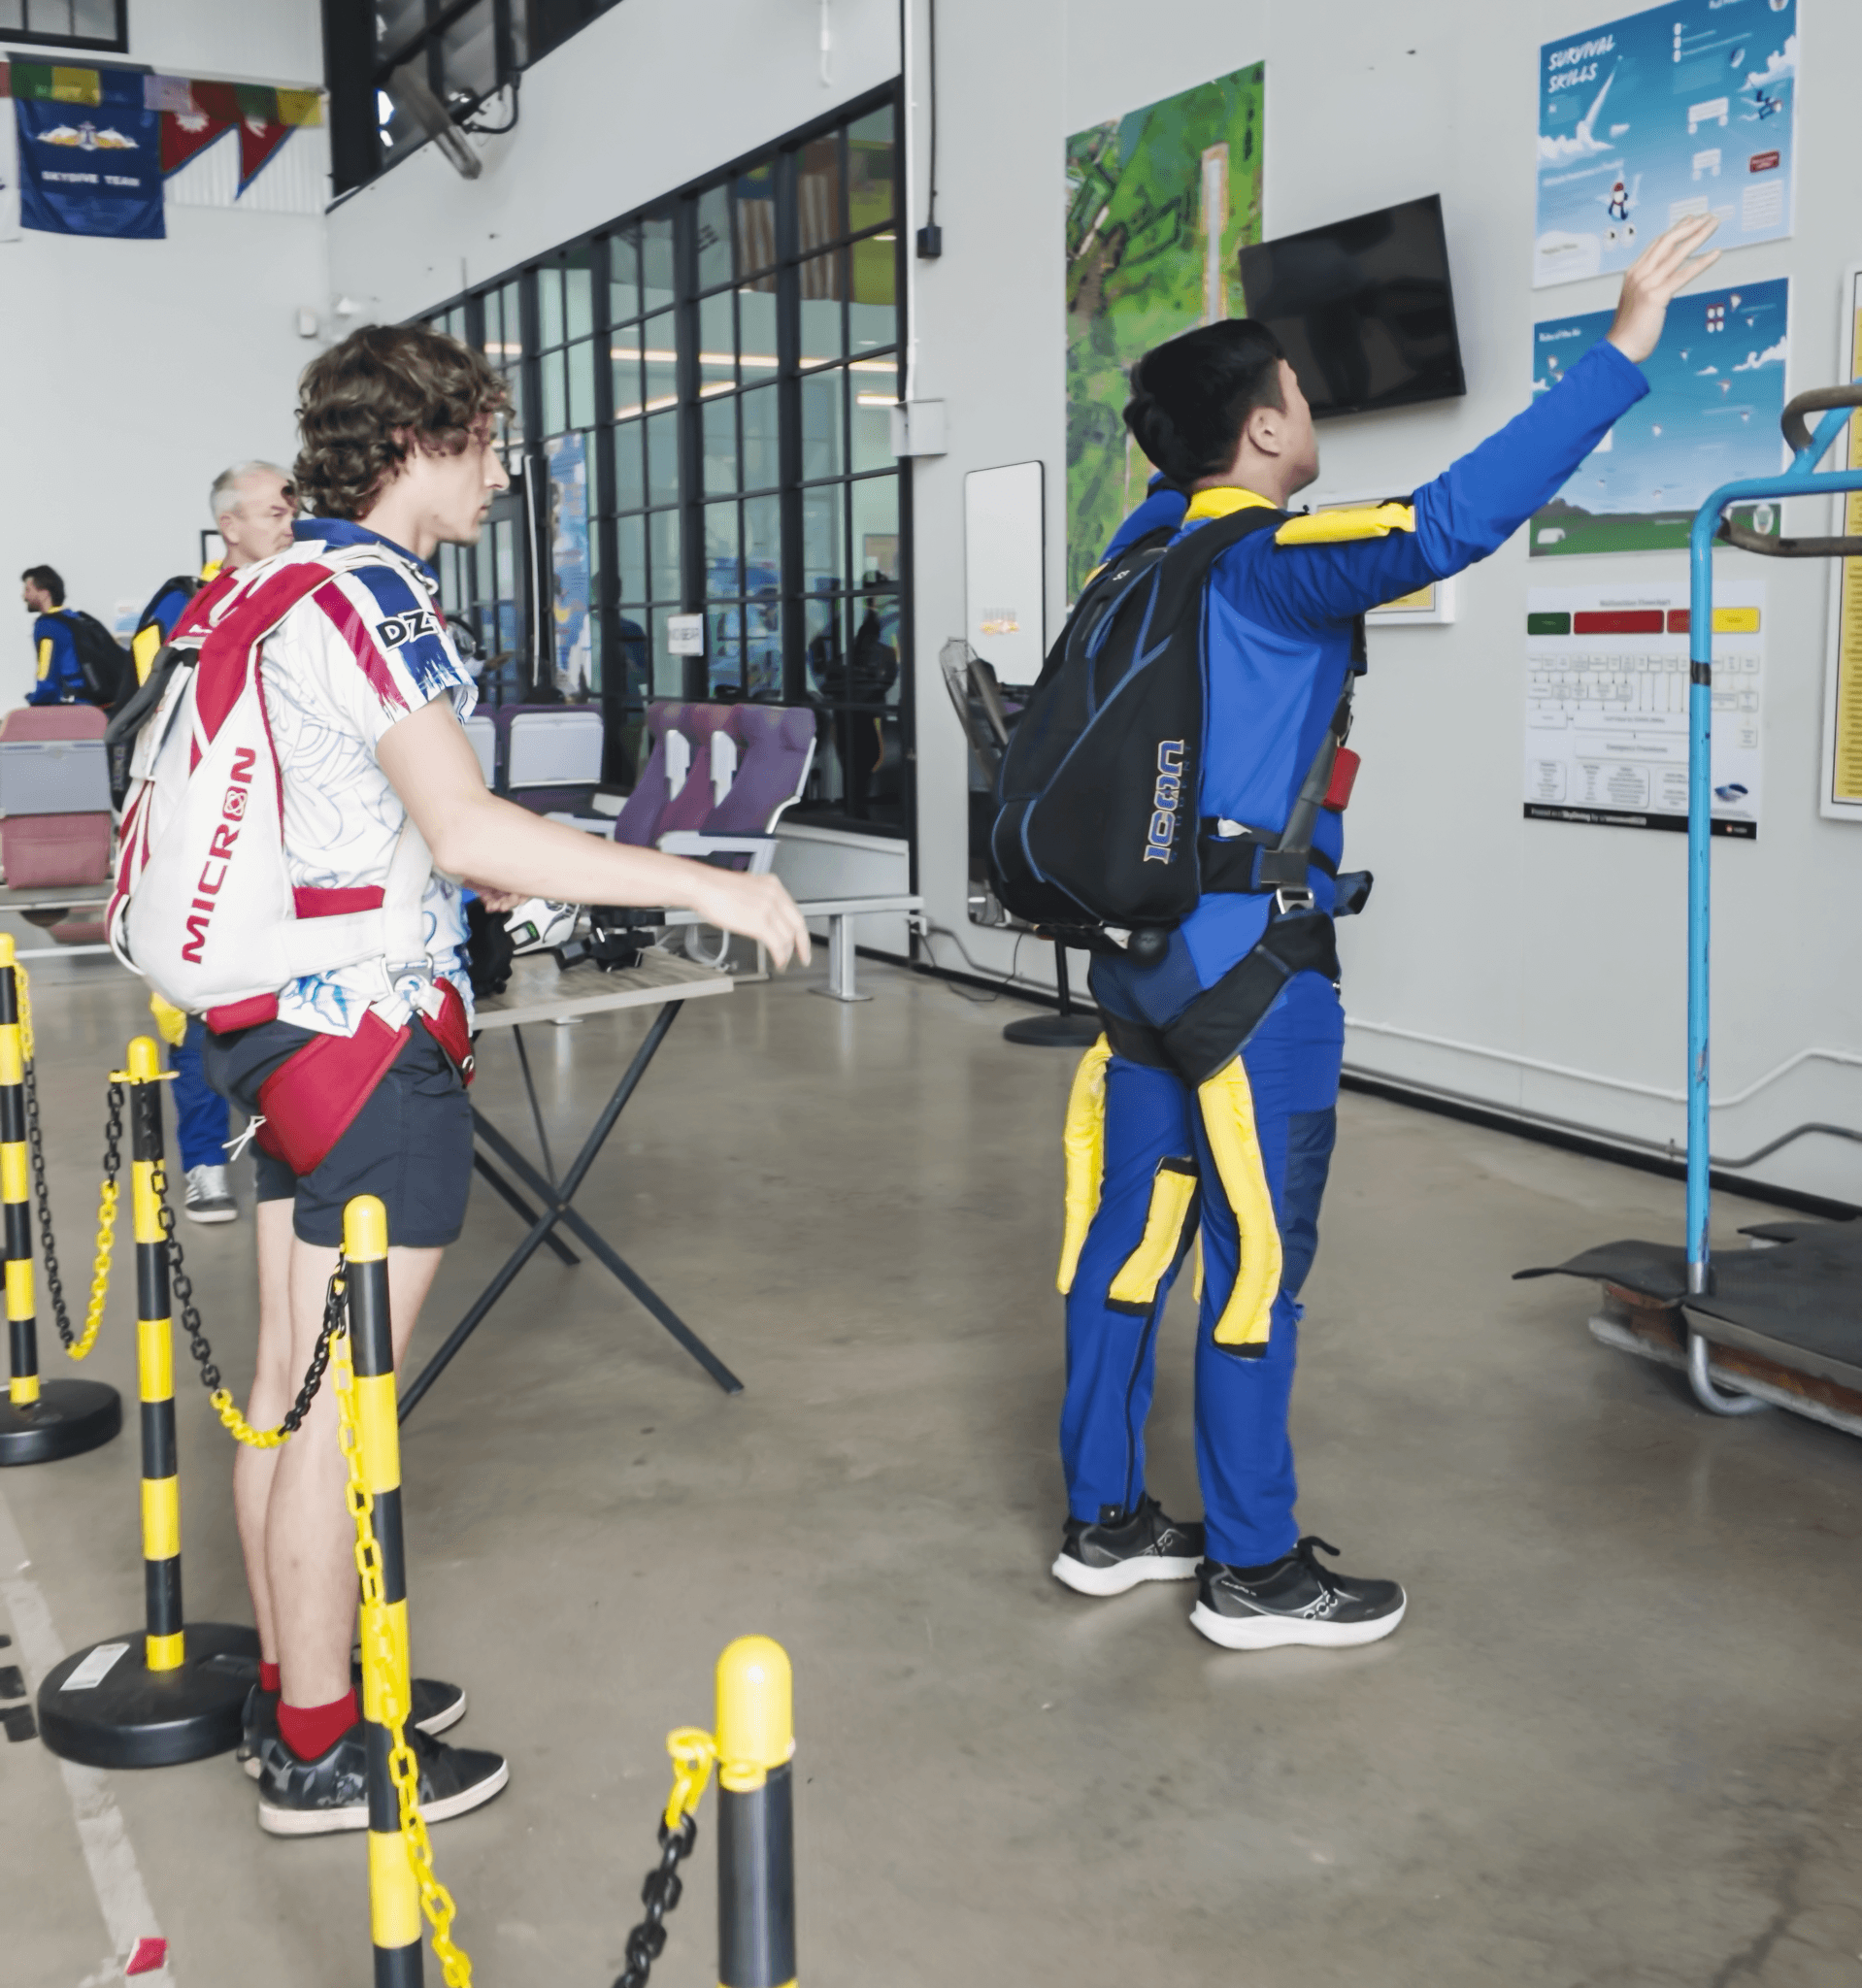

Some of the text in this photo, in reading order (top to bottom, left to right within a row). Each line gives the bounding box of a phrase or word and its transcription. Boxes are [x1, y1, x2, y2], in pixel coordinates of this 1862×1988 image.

[1547, 34, 1615, 71] SURVIVAL
[1547, 62, 1598, 93] SKILLS
[42, 170, 140, 187] SKYDIVE TEAM
[182, 746, 256, 964] MICRON
